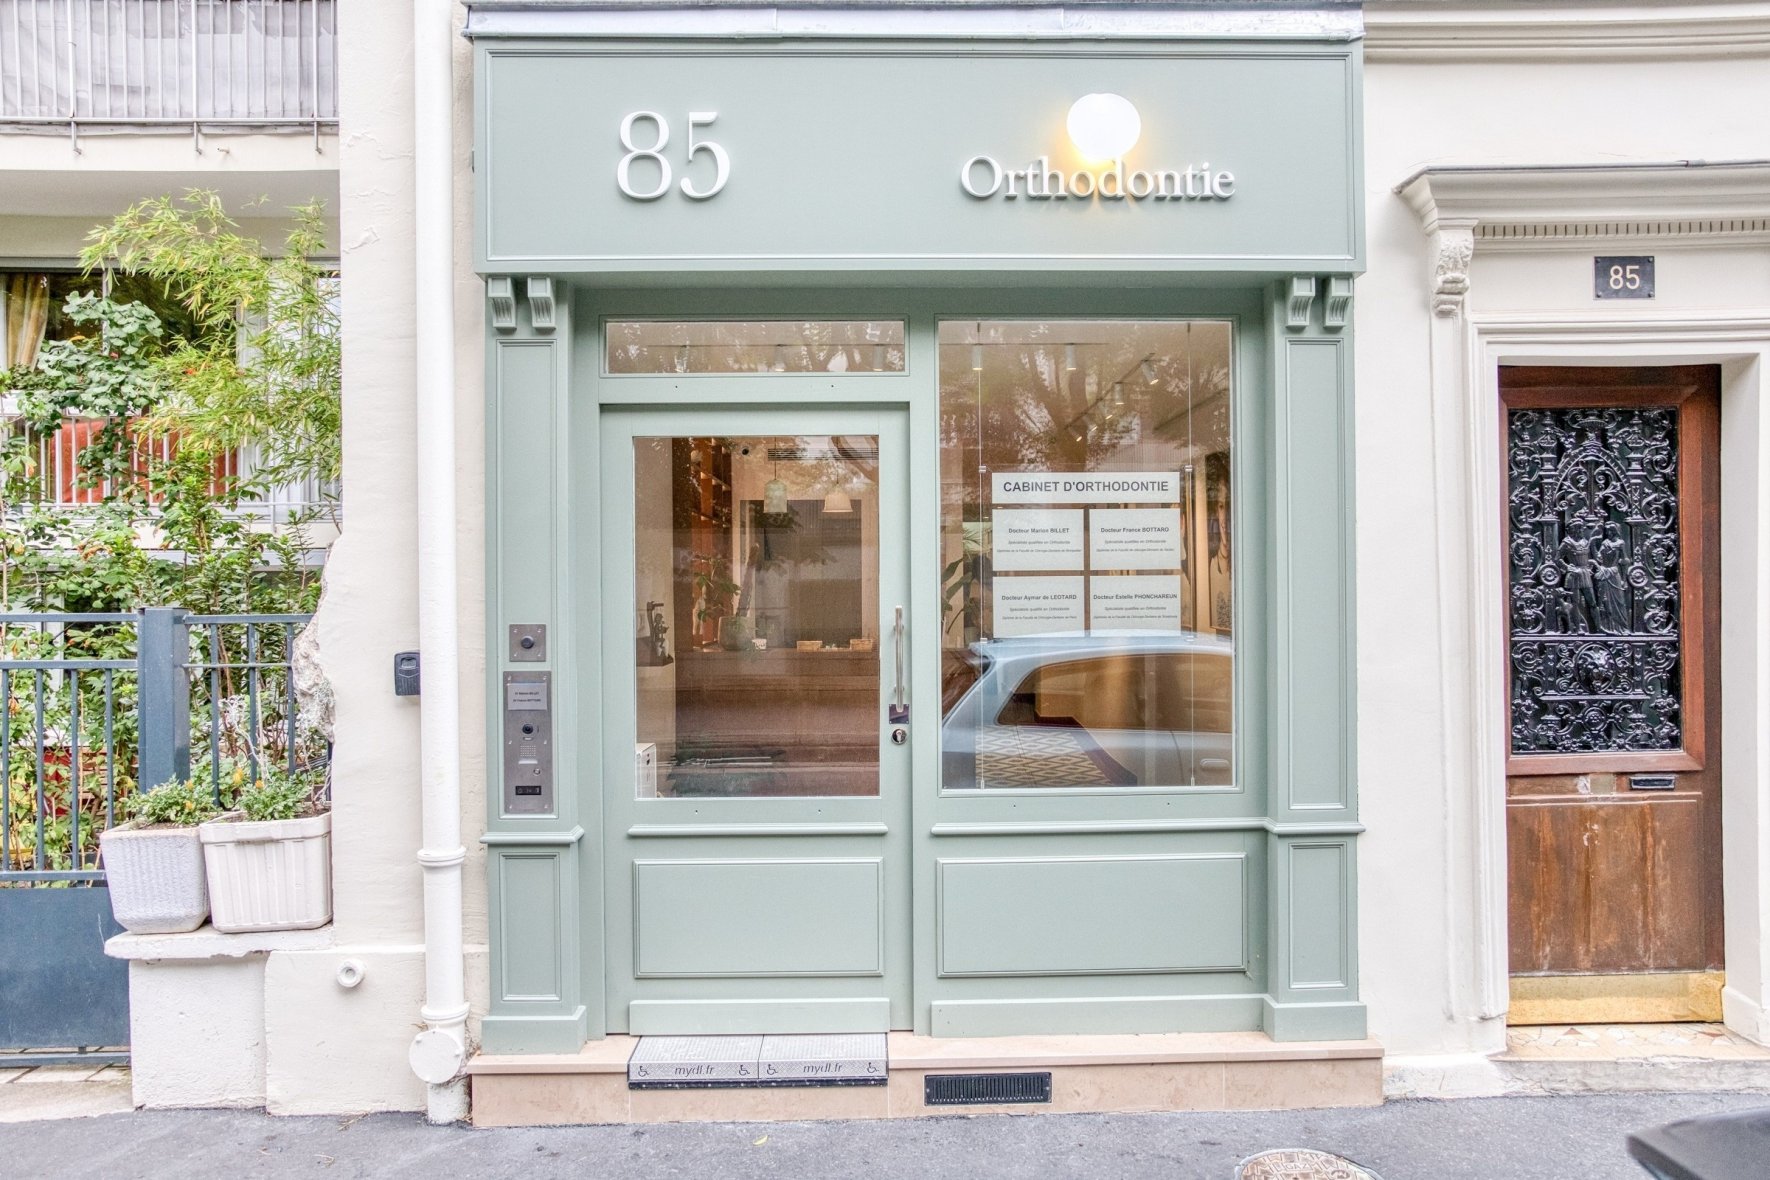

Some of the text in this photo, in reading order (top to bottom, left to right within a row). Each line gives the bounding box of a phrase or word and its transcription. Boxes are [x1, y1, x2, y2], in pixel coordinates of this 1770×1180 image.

[617, 110, 731, 199] 85
[960, 155, 1236, 199] Orthodontie
[1609, 265, 1640, 290] 85
[1003, 481, 1169, 492] CABINET D'ORTHODONTIE
[674, 1064, 715, 1077] mydl.fr
[803, 1062, 843, 1075] mydl.fr
